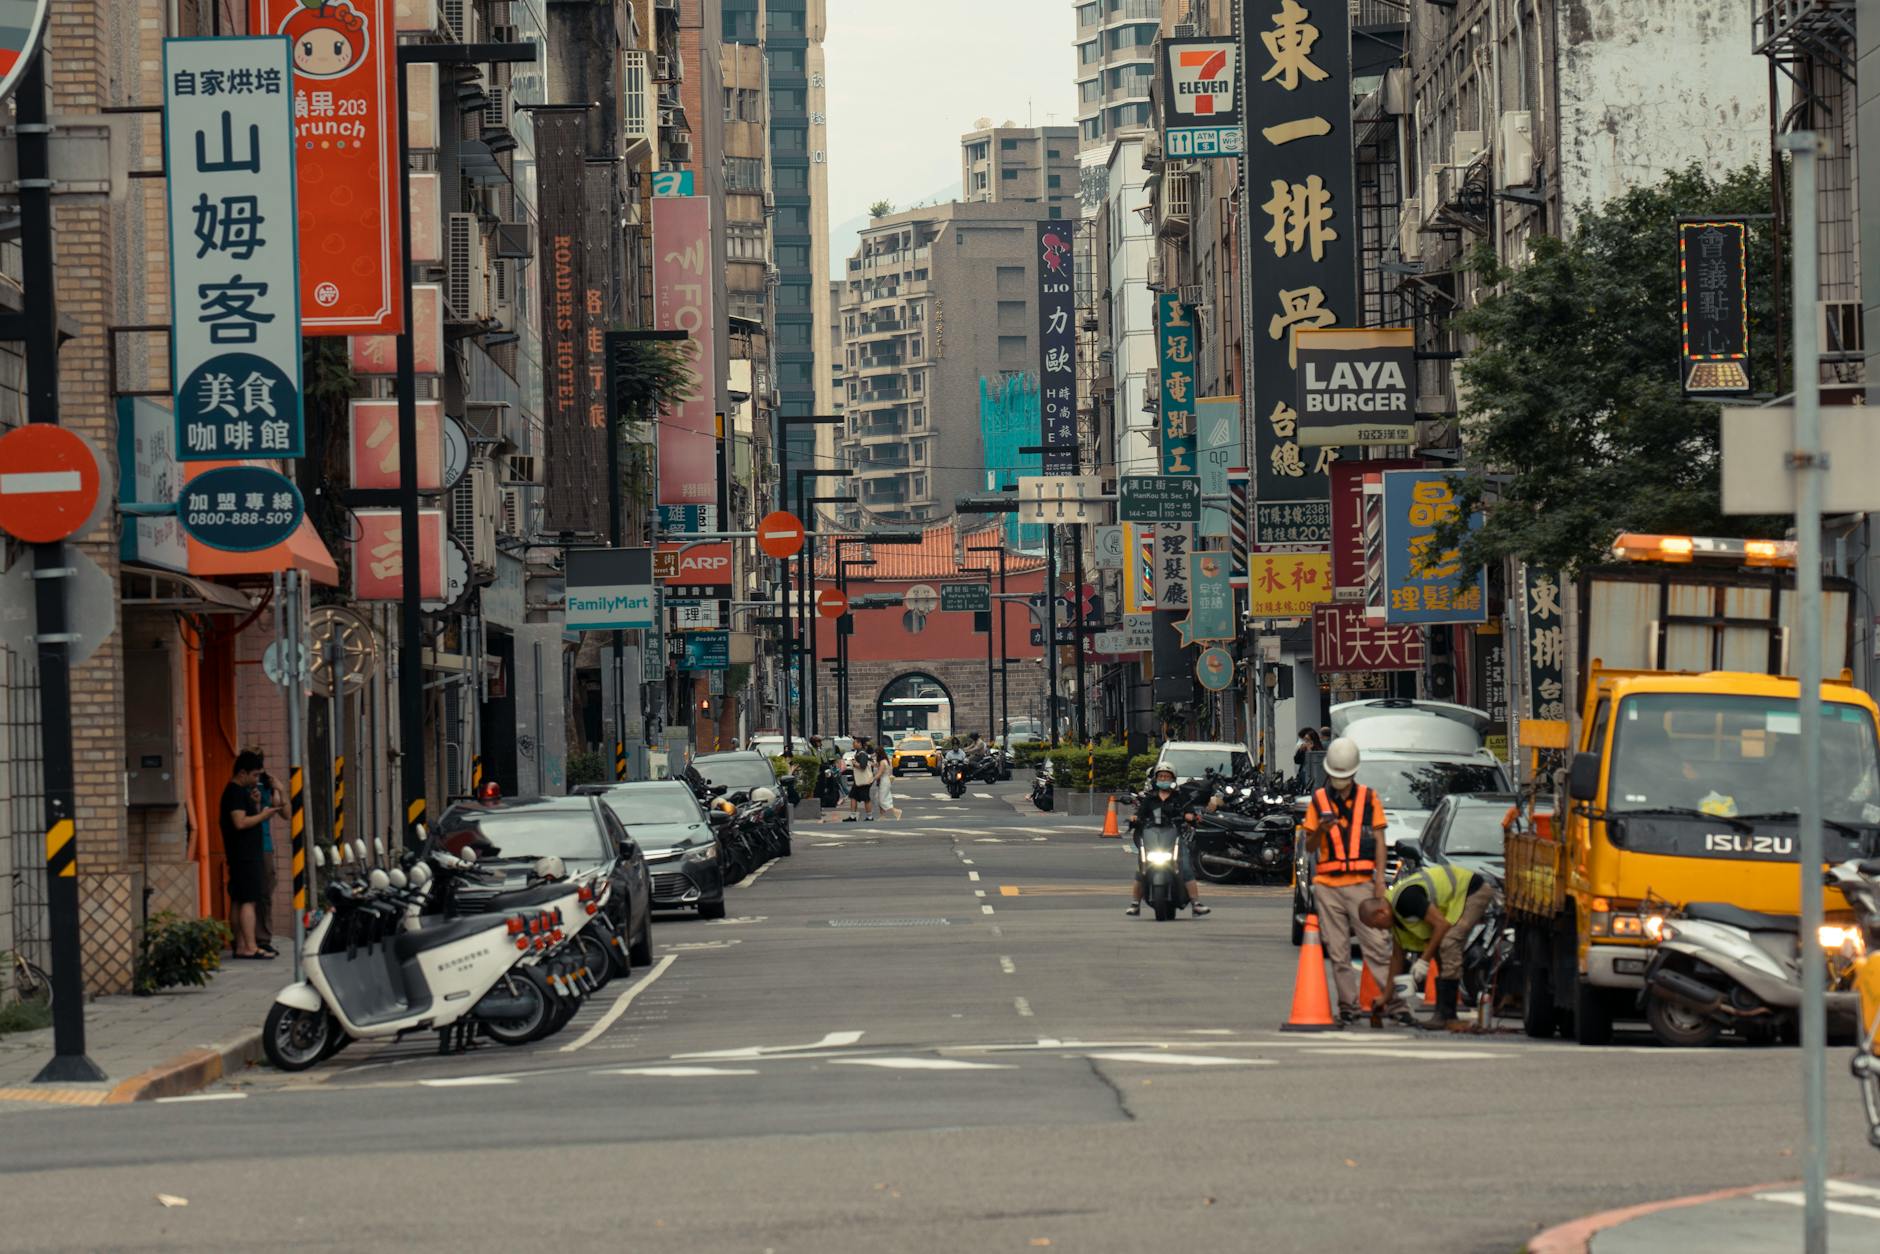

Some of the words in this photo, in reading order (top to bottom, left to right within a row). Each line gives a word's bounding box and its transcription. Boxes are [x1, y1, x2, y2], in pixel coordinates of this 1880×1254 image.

[173, 67, 281, 96] 自家烘培
[338, 99, 367, 116] 203
[1197, 132, 1215, 140] ATM
[811, 150, 827, 163] 101
[1260, 0, 1337, 370] 東一排骨
[191, 110, 277, 345] 山姆客
[554, 235, 573, 331] ROADERS
[1043, 283, 1070, 293] LIO
[1045, 305, 1072, 373] 力歐
[557, 341, 574, 412] HOTEL
[1305, 361, 1406, 390] LAYA
[197, 370, 278, 419] 美食
[1306, 393, 1407, 412] BURGER
[187, 419, 290, 452] 咖啡館
[1128, 480, 1193, 491] 漢口街一段
[188, 492, 293, 511] 加盟專線
[188, 511, 293, 525] 0800-888-509
[680, 557, 729, 570] ARP
[568, 596, 649, 614] FamilyMart
[1391, 585, 1481, 612] 理髮廳
[1490, 737, 1507, 745] LAY
[1705, 833, 1793, 855] ISUZU
